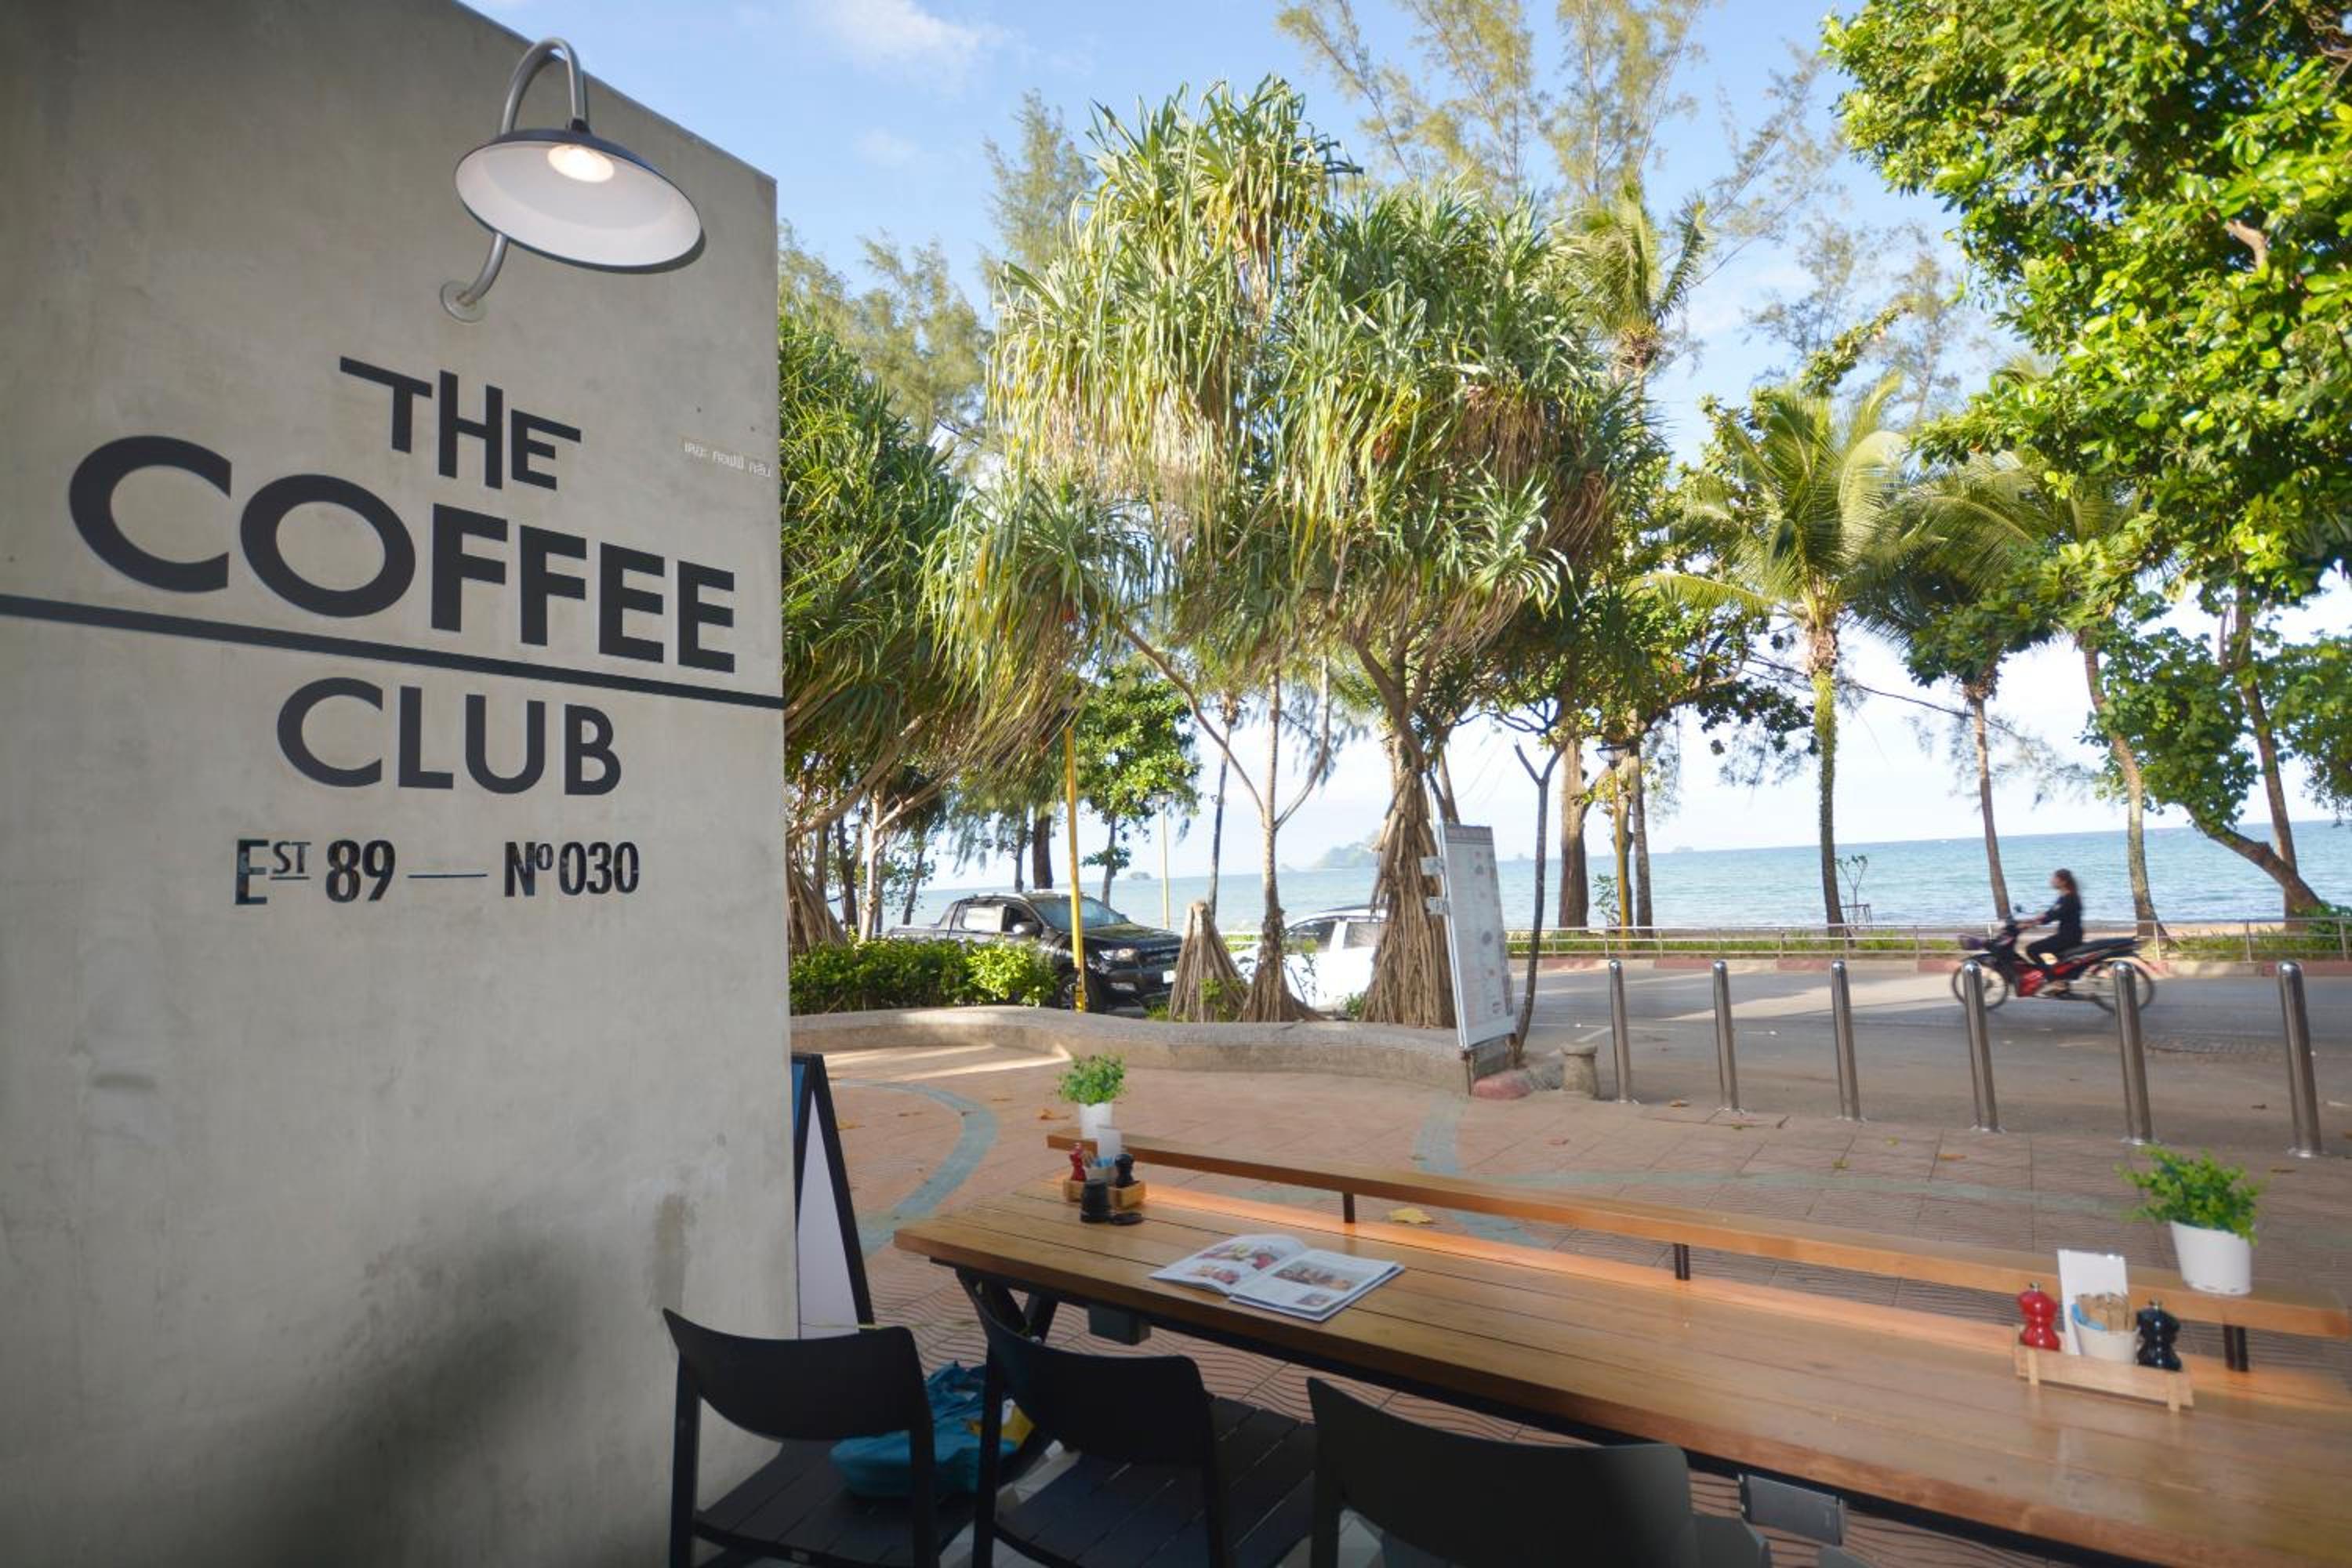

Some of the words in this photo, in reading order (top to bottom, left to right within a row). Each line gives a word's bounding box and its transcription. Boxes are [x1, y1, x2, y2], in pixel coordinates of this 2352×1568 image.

[340, 357, 581, 491] THE
[69, 435, 735, 673] COFFEE
[277, 677, 622, 796] CLUB
[235, 839, 311, 906] EST
[325, 839, 396, 903] 89
